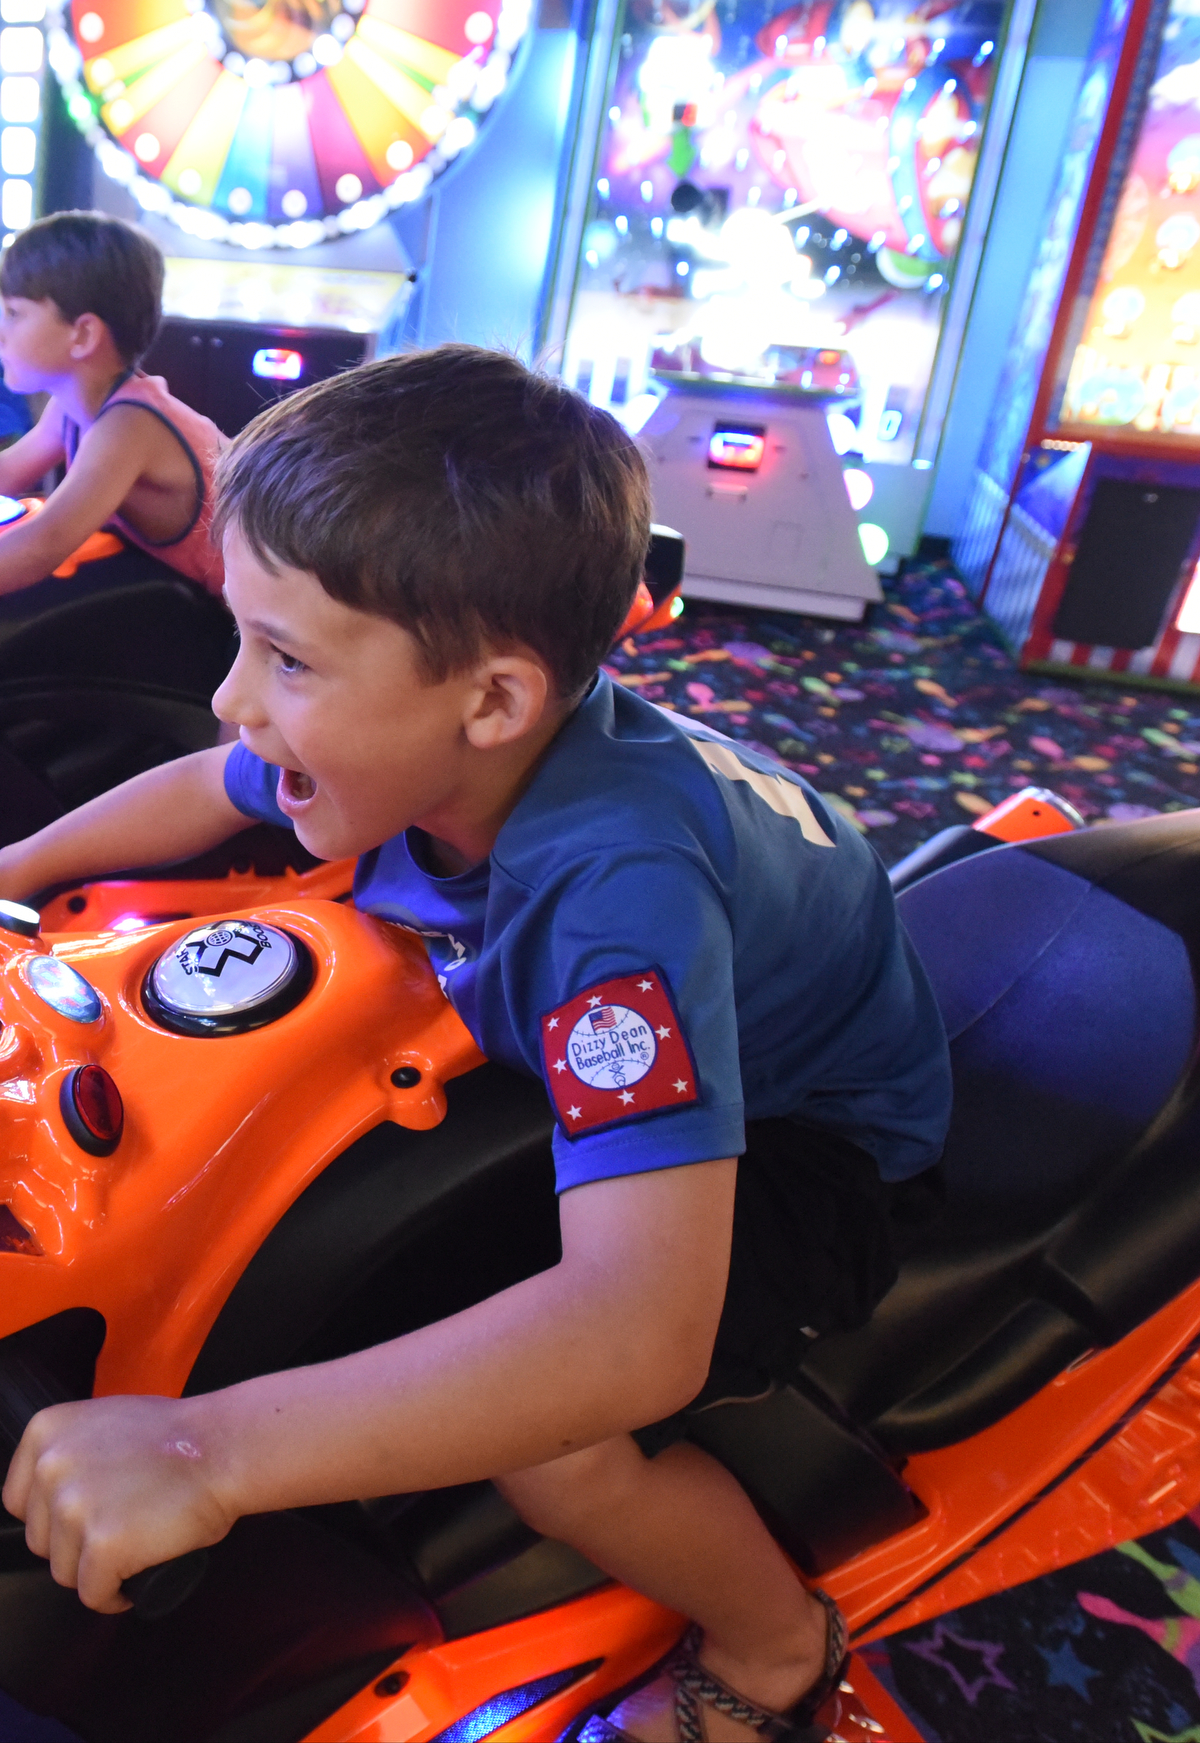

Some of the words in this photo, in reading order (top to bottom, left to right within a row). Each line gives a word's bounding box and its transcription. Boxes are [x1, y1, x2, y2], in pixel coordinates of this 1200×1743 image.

[571, 1037, 606, 1057] Dizzy
[608, 1024, 648, 1044] Dean
[575, 1042, 626, 1071] Baseball
[627, 1039, 651, 1055] Inc.
